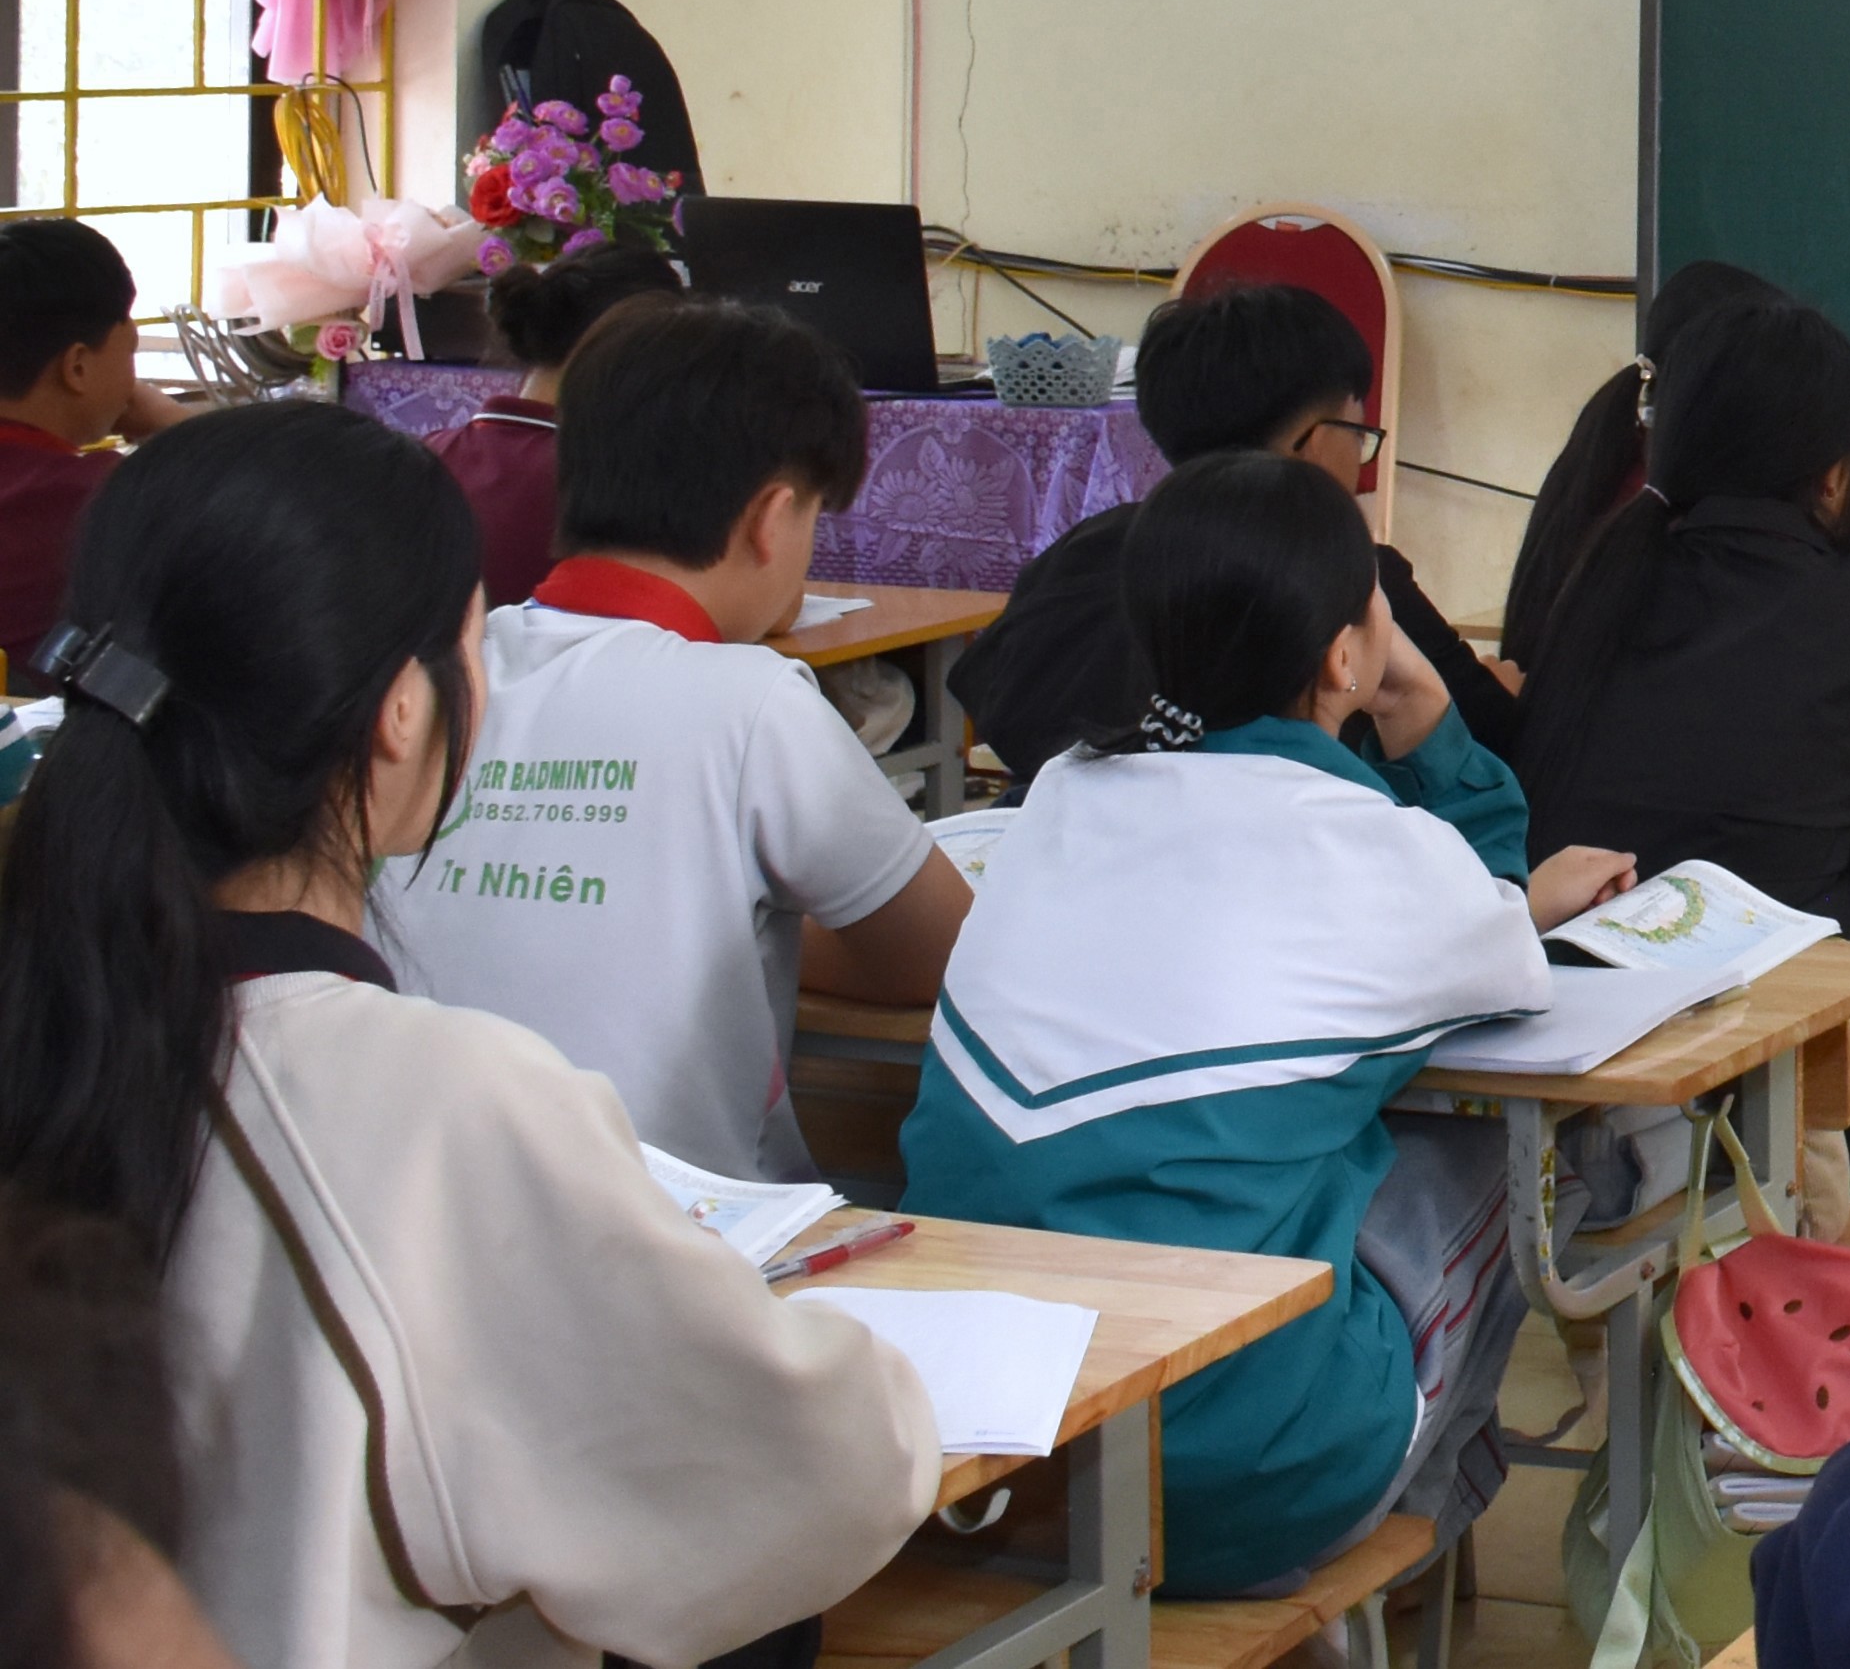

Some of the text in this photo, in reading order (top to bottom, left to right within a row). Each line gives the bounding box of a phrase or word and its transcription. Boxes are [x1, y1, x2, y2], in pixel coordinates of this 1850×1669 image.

[789, 281, 823, 293] acer
[510, 760, 637, 791] BADMINTON
[479, 862, 606, 905] Nhiên
